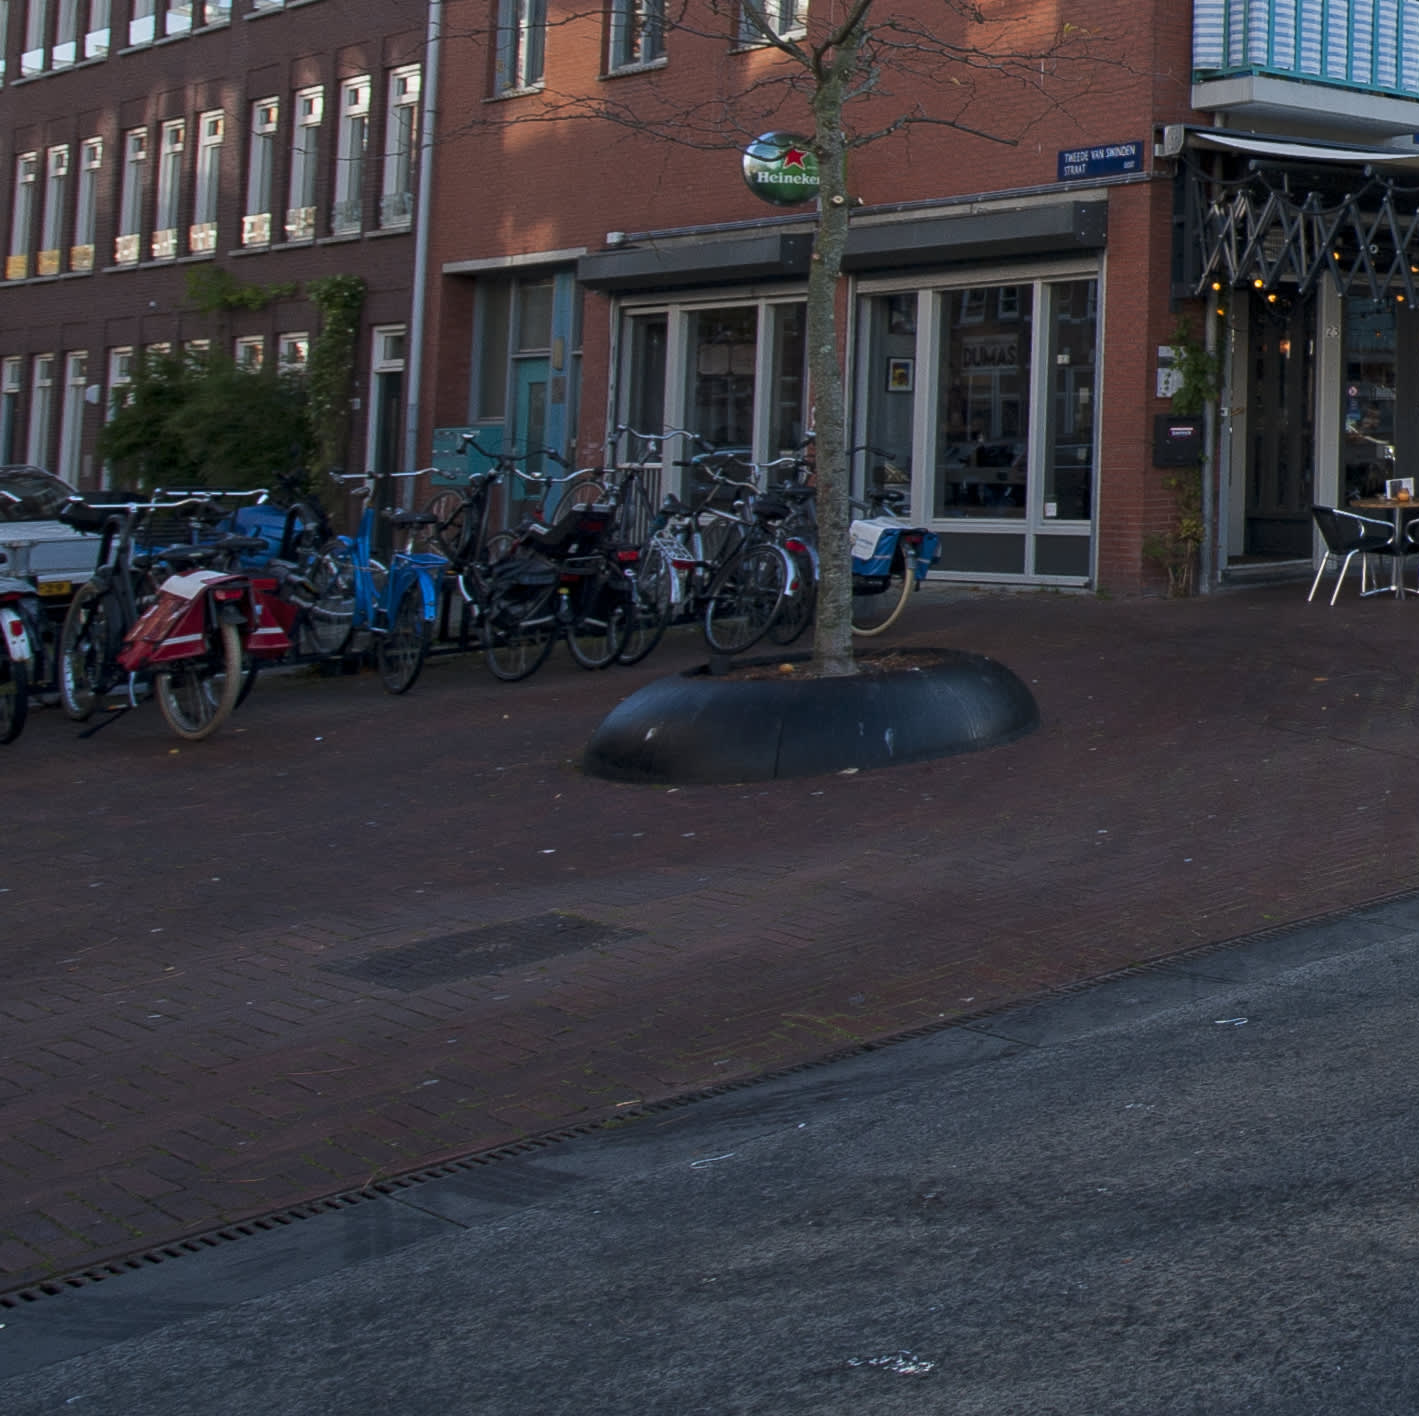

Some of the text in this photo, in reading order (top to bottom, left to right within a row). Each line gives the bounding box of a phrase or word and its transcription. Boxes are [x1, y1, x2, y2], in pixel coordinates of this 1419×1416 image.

[1064, 144, 1136, 163] TWEEDE VAN SWINDEN
[1064, 163, 1087, 177] STRAAT
[963, 344, 1017, 366] DUMAS
